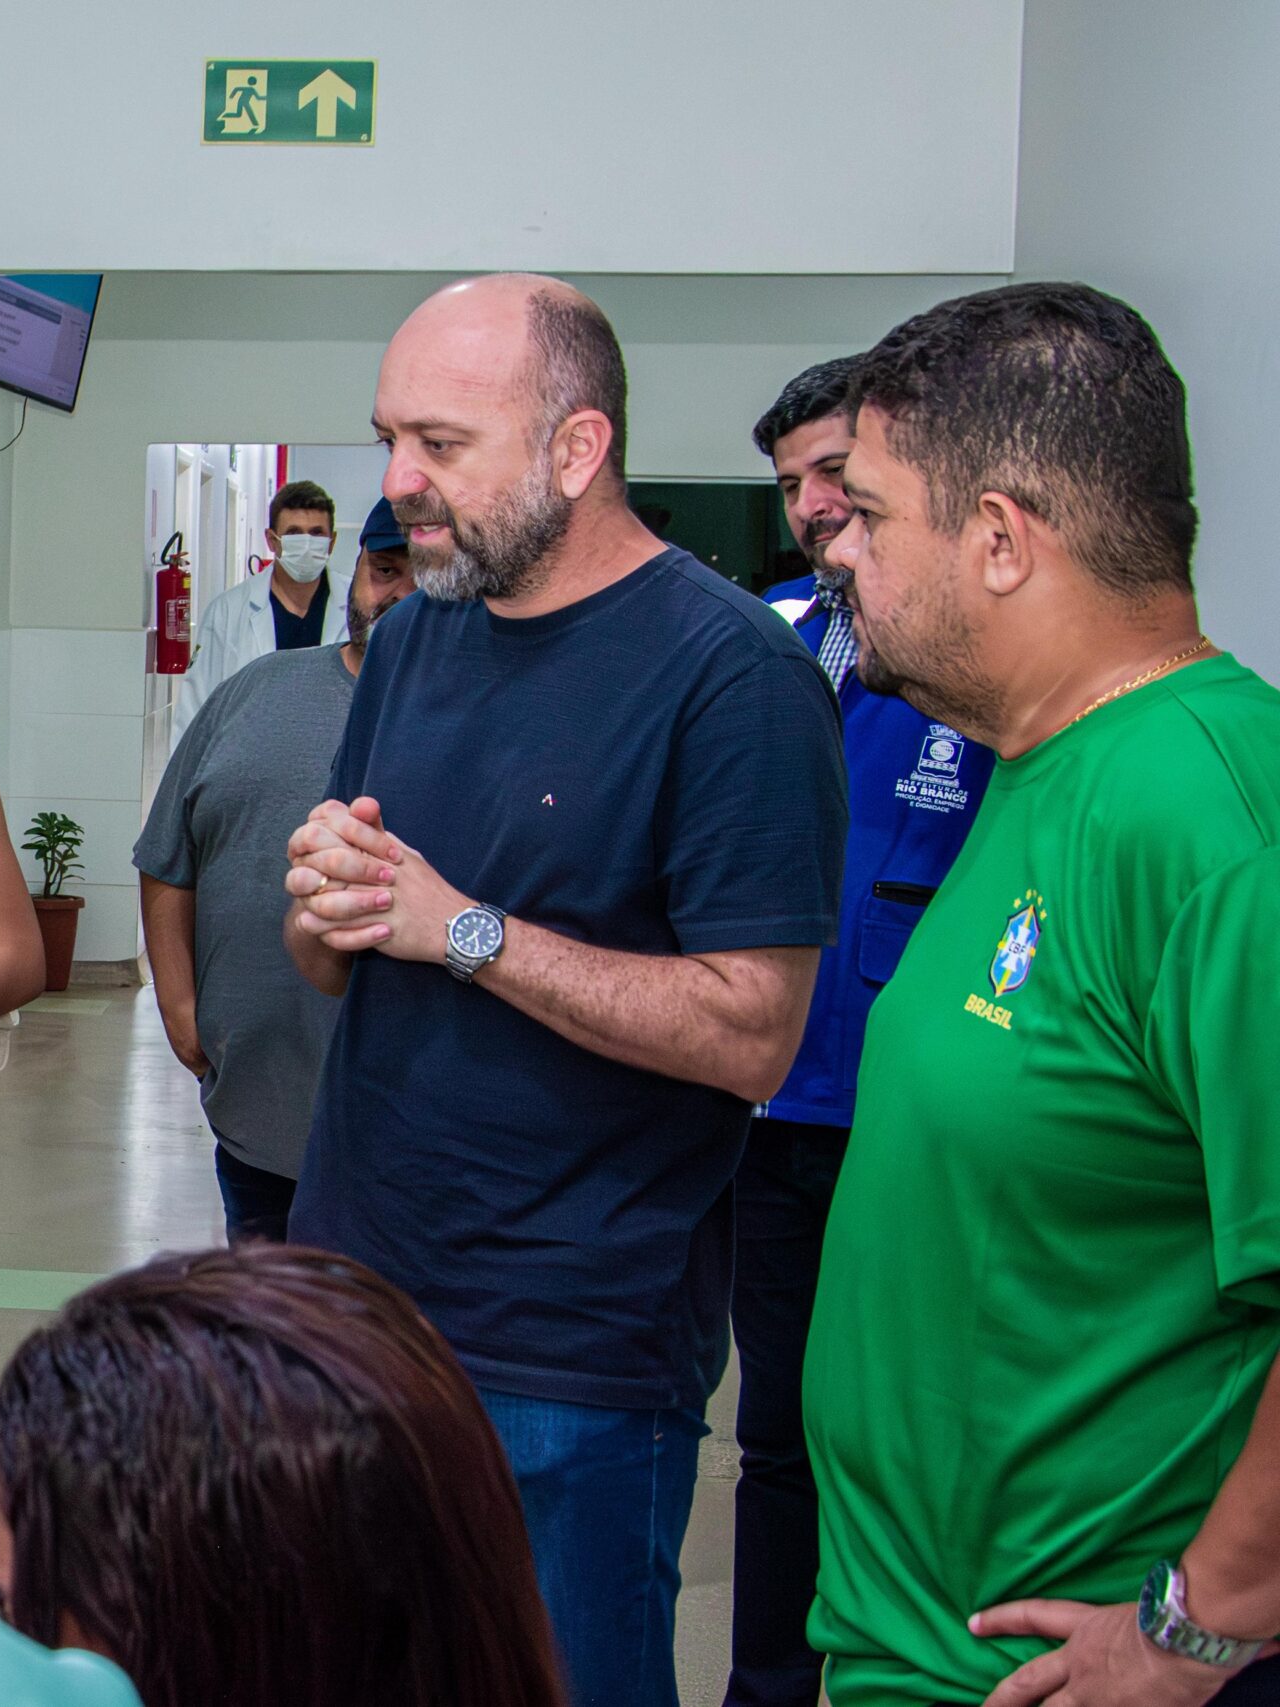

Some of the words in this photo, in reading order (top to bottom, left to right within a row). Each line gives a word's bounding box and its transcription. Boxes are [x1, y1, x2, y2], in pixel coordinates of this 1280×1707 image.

[895, 783, 917, 794] RIO
[920, 787, 967, 803] BRANCO
[897, 779, 956, 793] PREFEITURA
[915, 802, 950, 813] DIGNIDADE
[934, 798, 965, 810] EMPREGO
[964, 994, 1013, 1031] BRASIL
